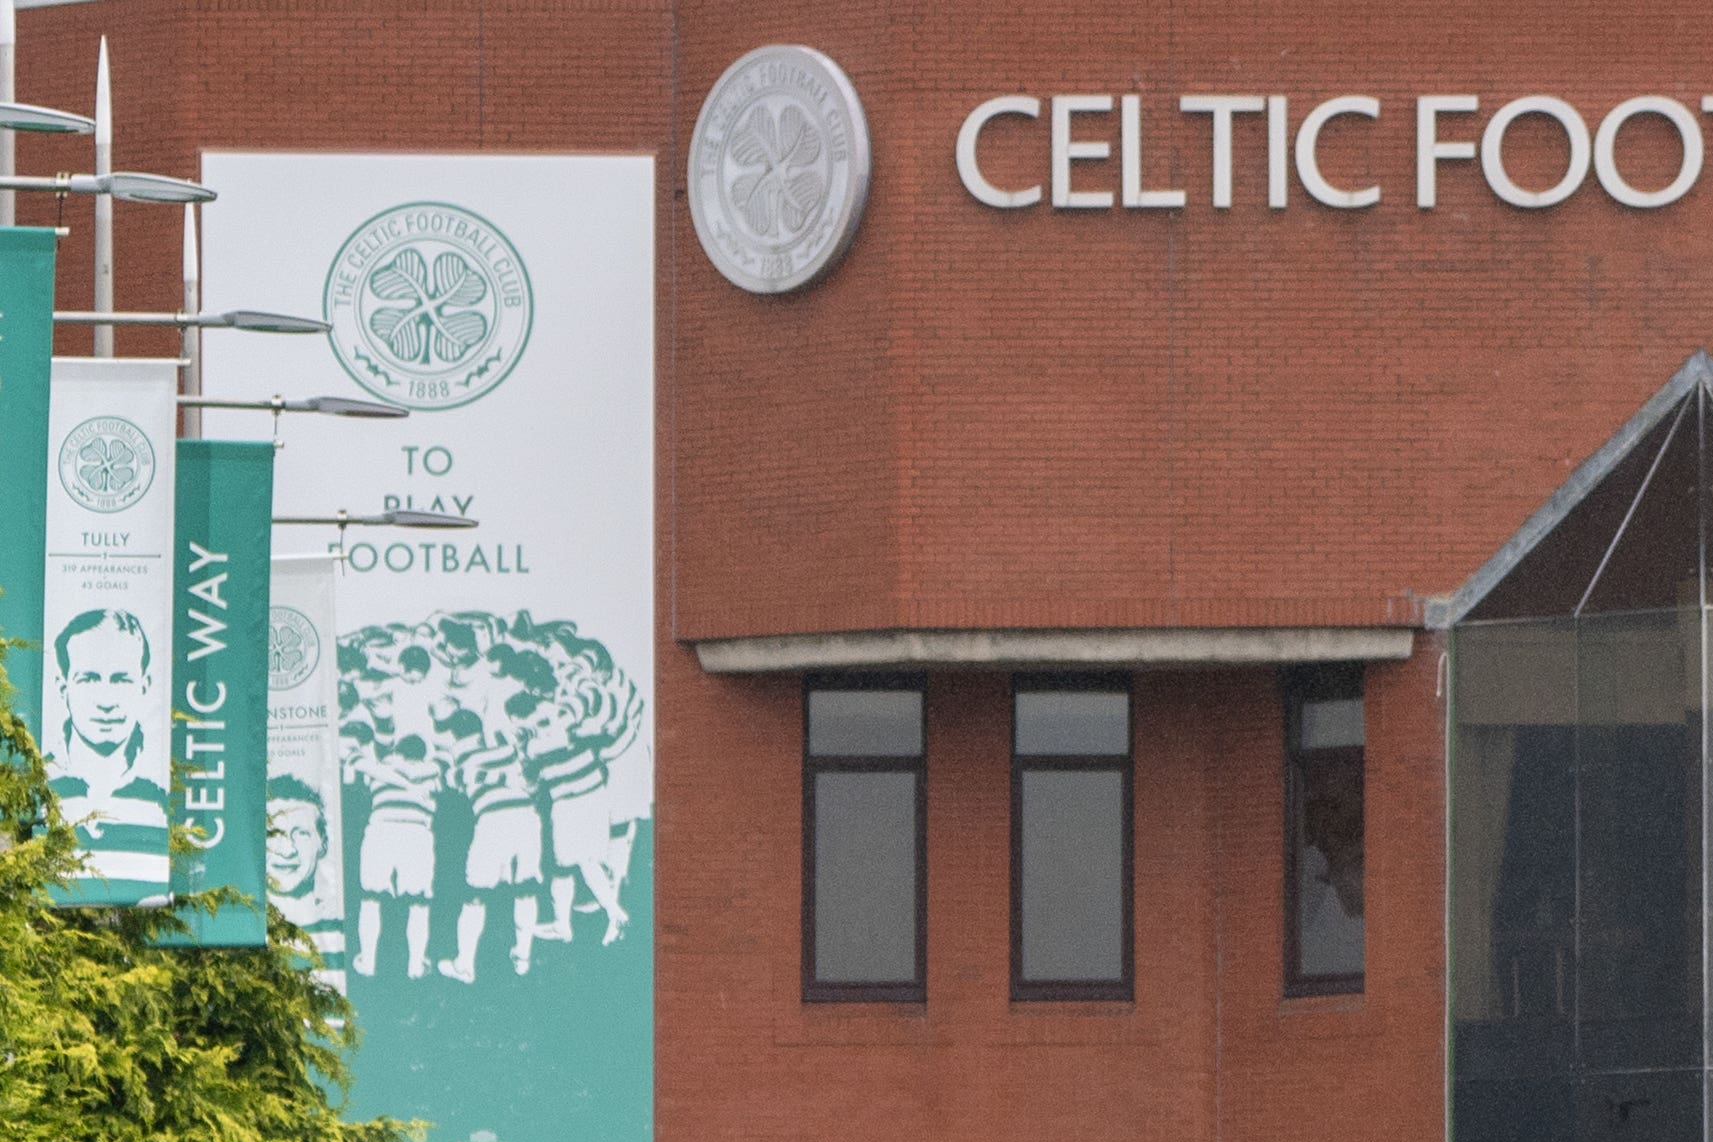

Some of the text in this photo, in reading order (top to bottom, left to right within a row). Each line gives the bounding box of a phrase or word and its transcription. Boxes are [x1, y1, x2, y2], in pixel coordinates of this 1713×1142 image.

[956, 94, 1381, 208] CELTIC
[334, 212, 522, 308] THE CELTIC FOOTBALL CLUB
[408, 380, 451, 399] 1888
[401, 445, 453, 477] TO
[81, 531, 131, 548] TULLY
[79, 564, 149, 575] APPEARANCES
[95, 580, 129, 591] GOALS
[184, 541, 228, 850] CELTIC WAY
